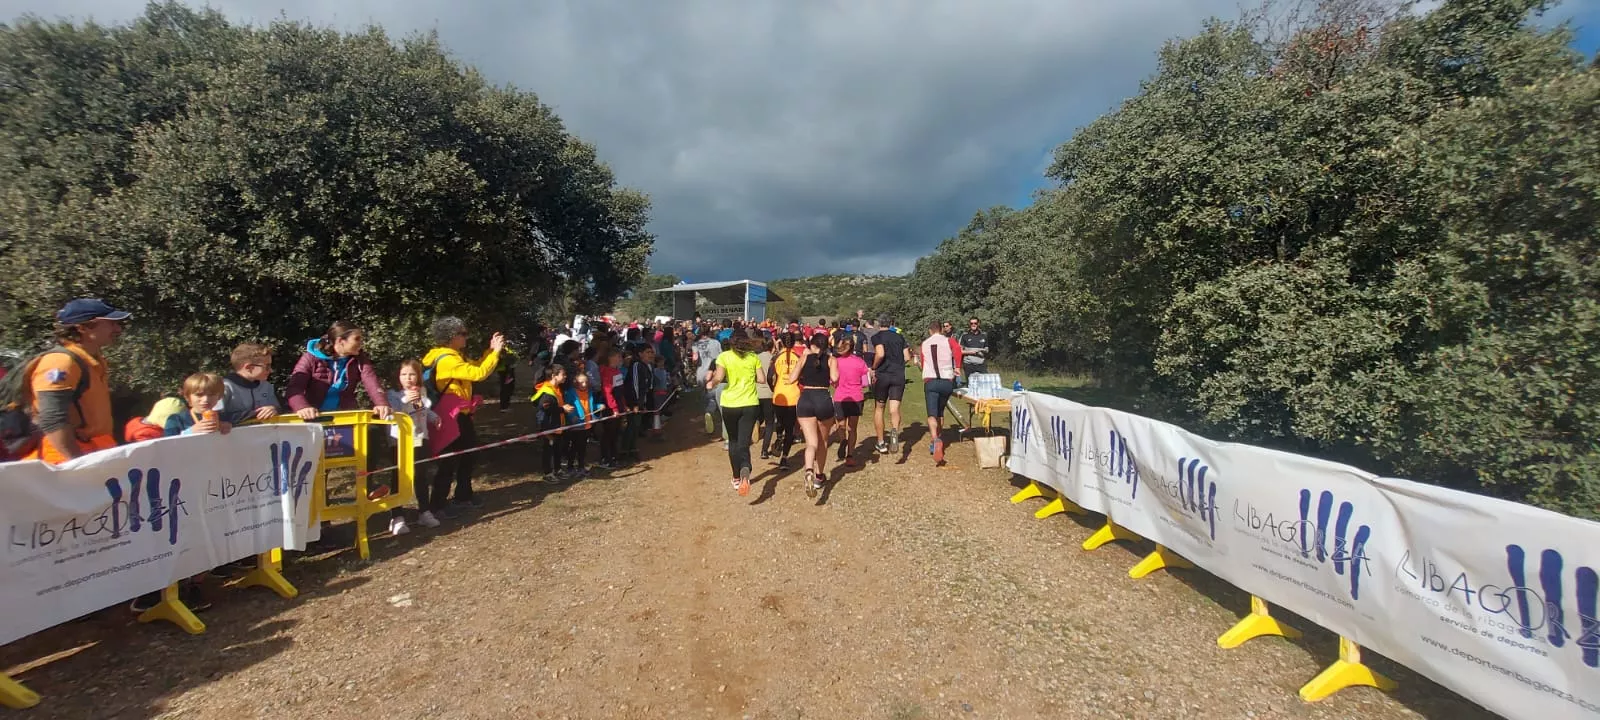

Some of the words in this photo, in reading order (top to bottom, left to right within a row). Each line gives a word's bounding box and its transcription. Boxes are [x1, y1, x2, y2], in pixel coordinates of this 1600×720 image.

[1440, 615, 1478, 634] servicio
[1481, 630, 1494, 639] de
[1497, 635, 1549, 658] deportes
